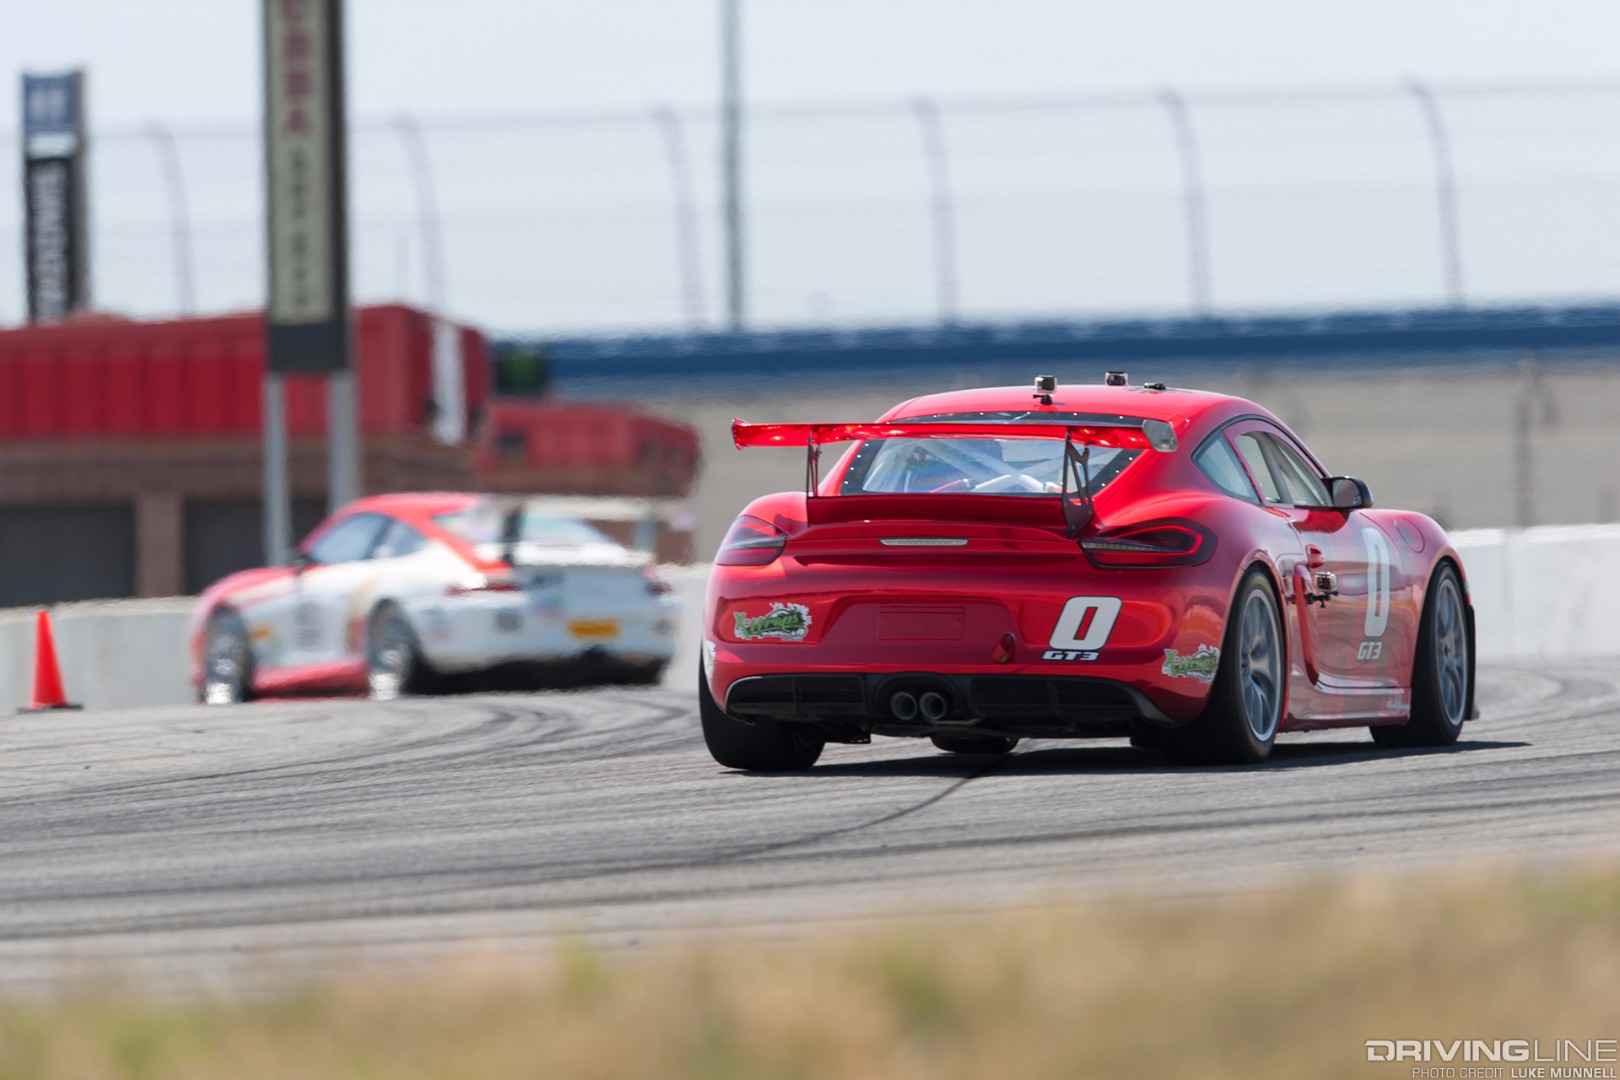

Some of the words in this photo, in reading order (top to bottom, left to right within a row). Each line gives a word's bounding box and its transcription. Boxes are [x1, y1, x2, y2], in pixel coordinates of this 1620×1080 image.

[1360, 527, 1391, 637] 0
[1049, 596, 1122, 650] 0
[1042, 650, 1100, 662] GT3
[1357, 642, 1382, 660] GT3
